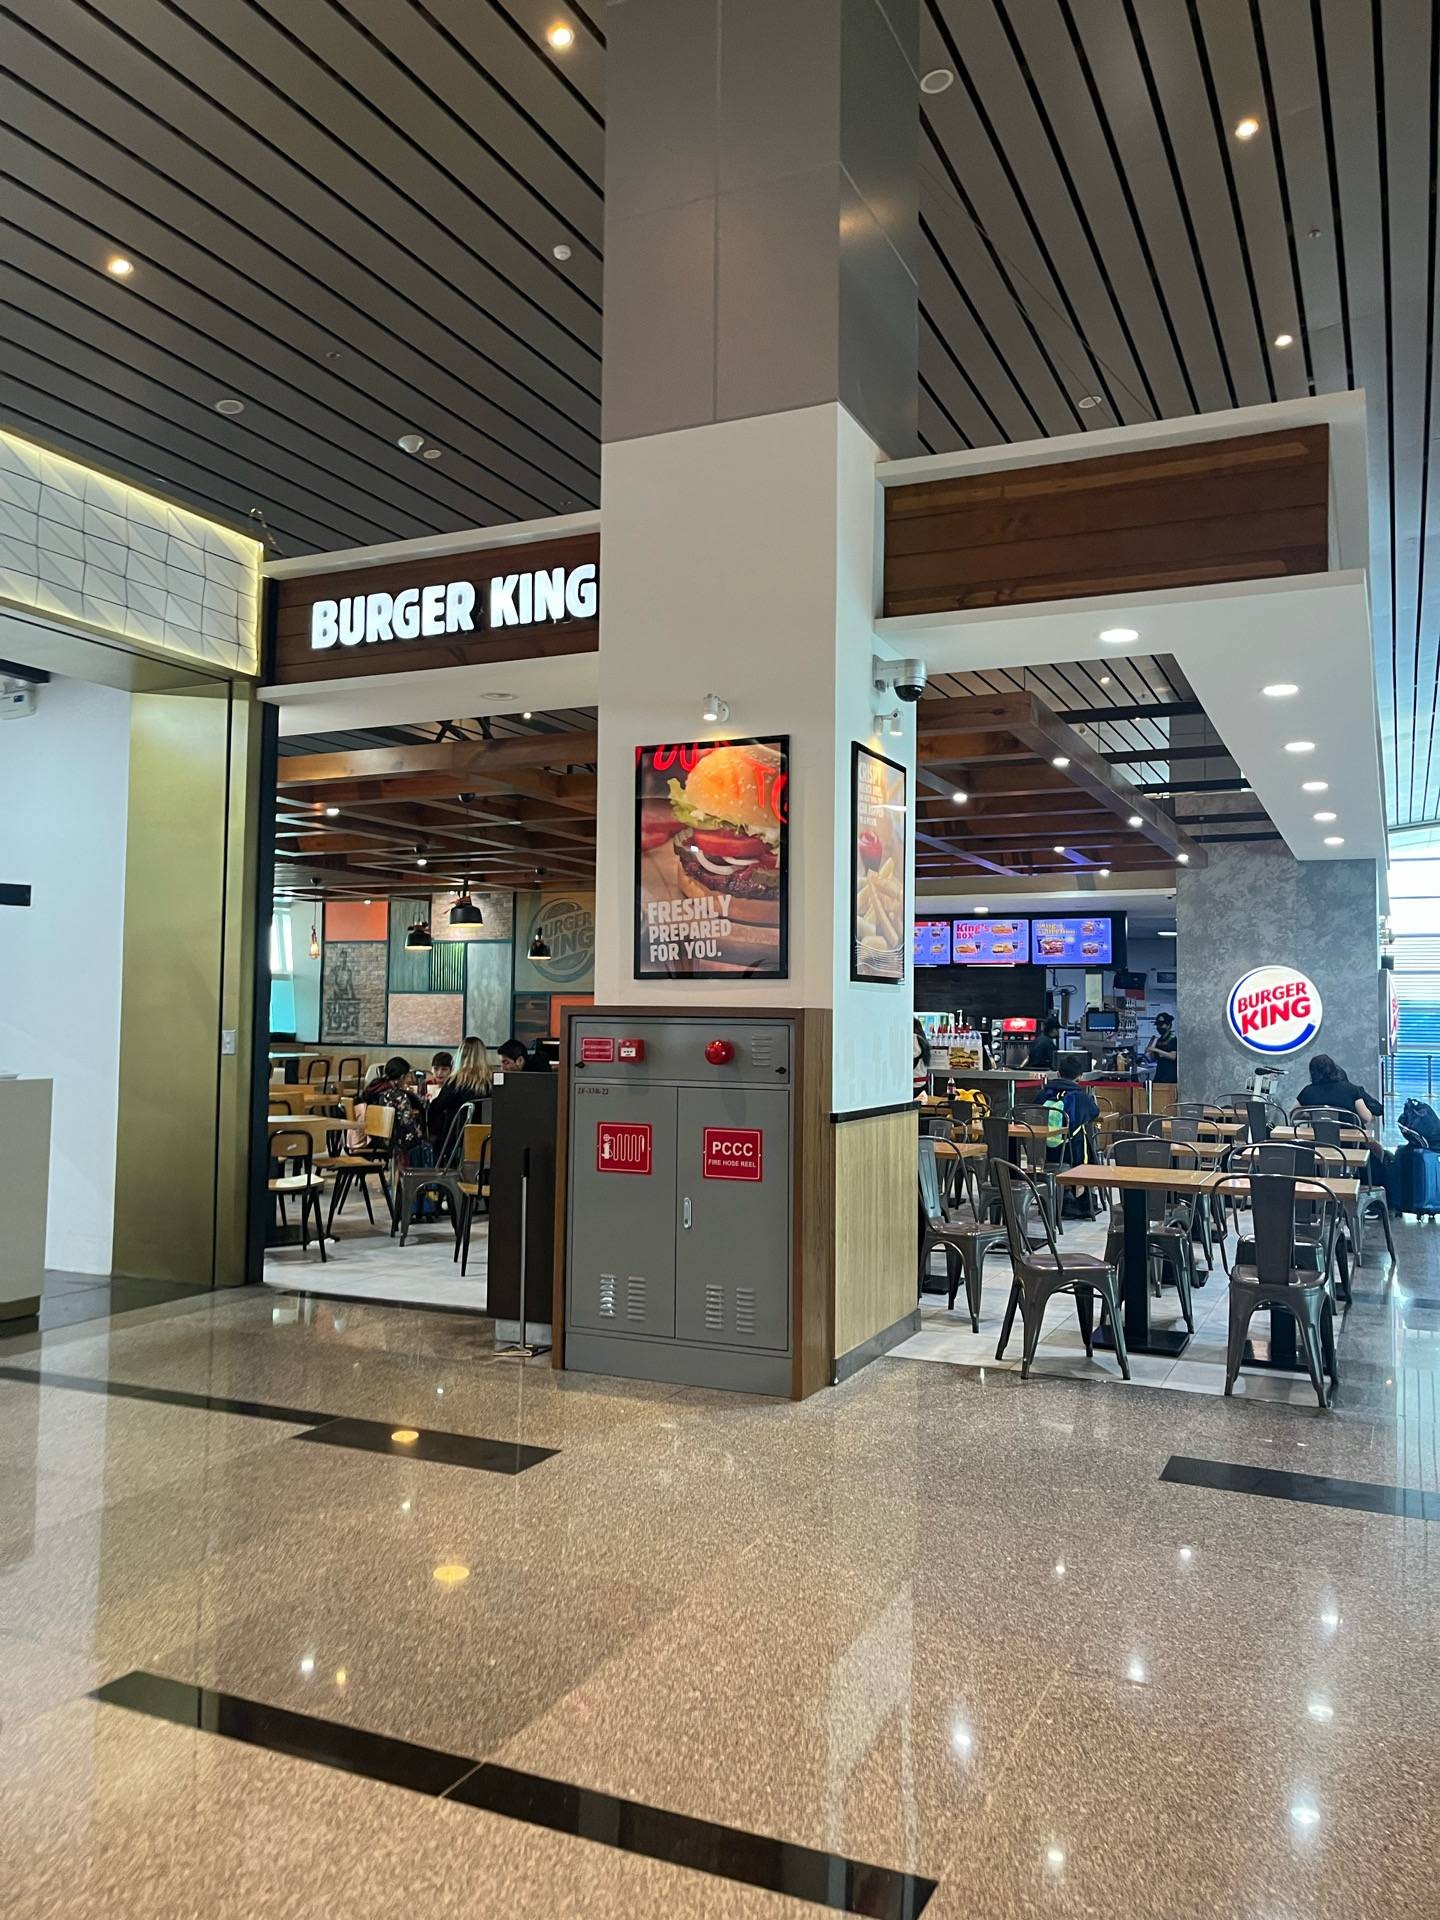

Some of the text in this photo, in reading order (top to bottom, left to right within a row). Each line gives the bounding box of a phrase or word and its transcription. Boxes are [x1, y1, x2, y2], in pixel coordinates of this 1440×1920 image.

[311, 563, 598, 650] BURGER KING
[648, 894, 732, 924] FRESHLY
[648, 919, 732, 943] PREPARED
[957, 923, 990, 934] King's
[650, 939, 722, 962] FOR YOU.
[1238, 982, 1307, 1014] BURGER
[1242, 996, 1311, 1035] KING
[712, 1141, 753, 1156] PCCC
